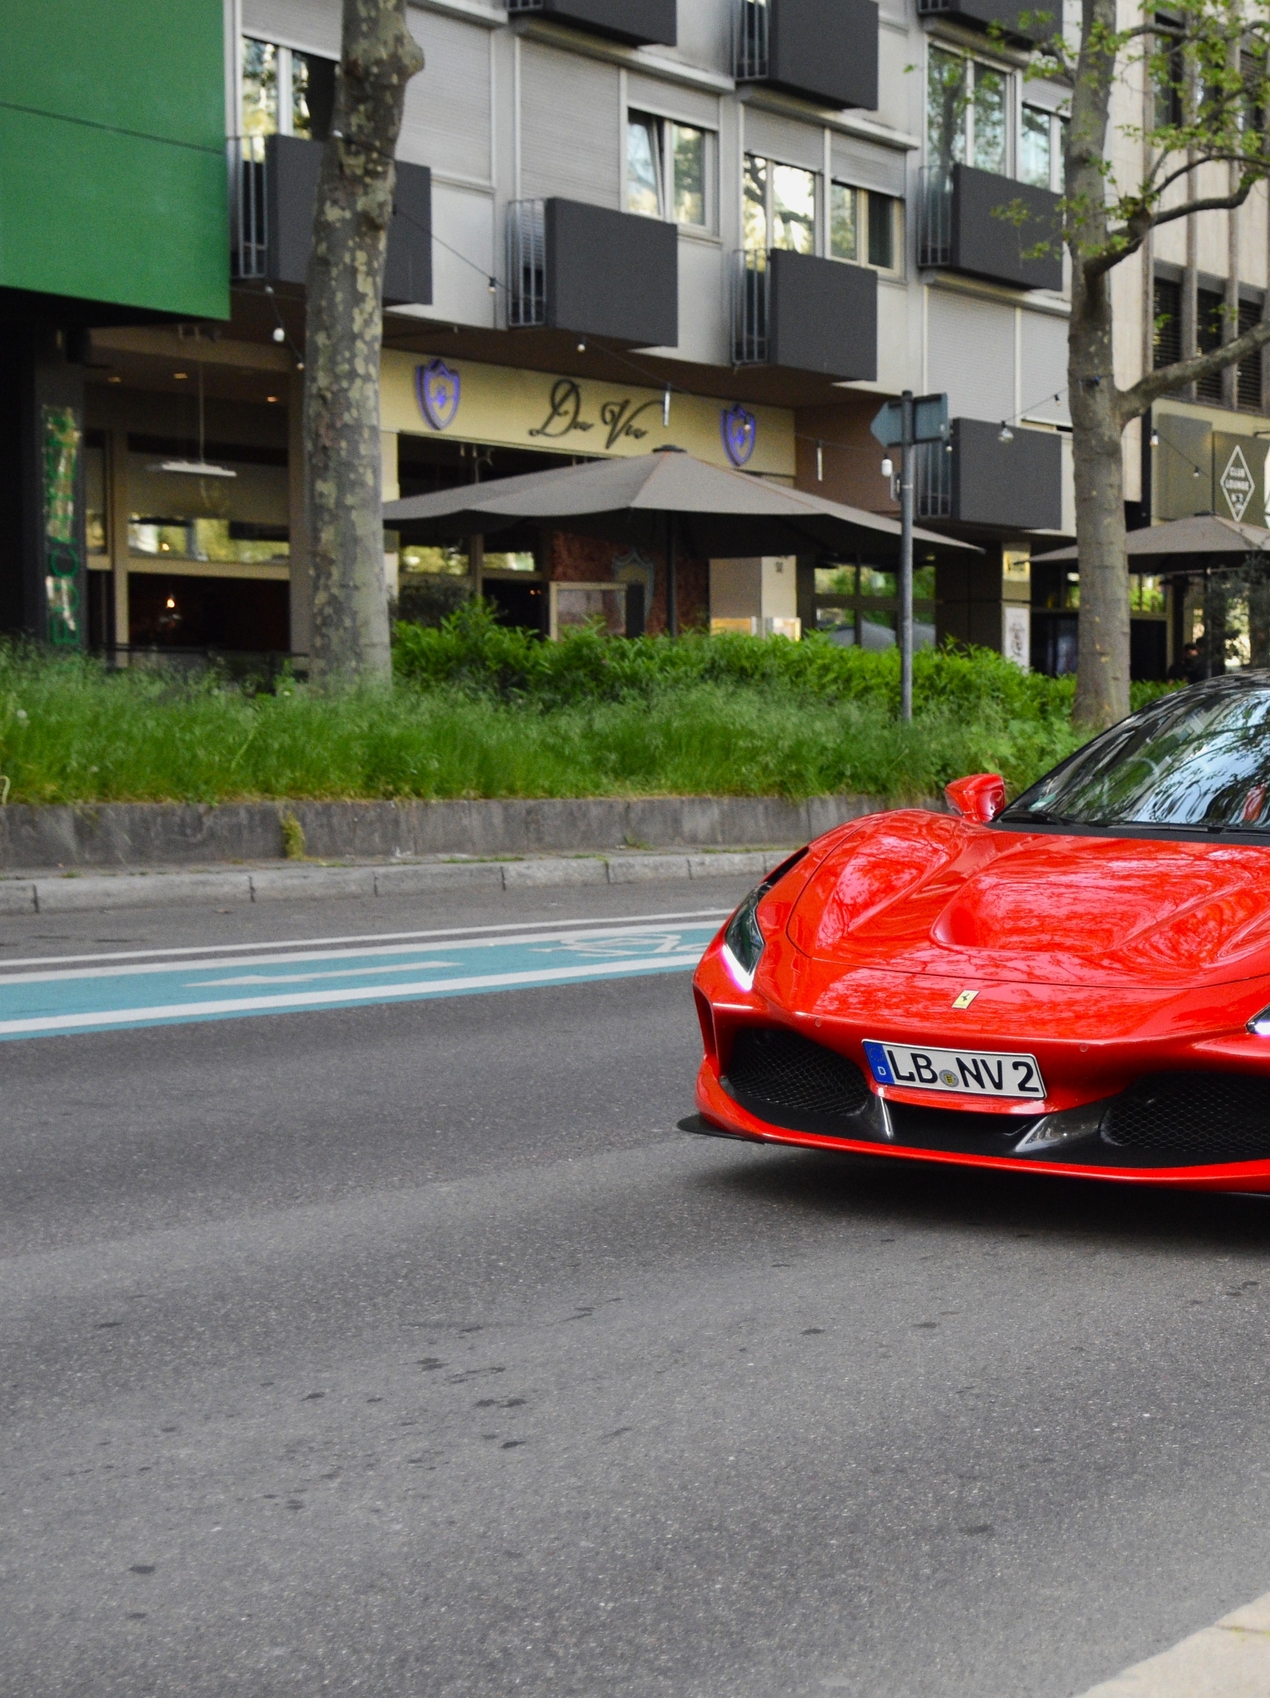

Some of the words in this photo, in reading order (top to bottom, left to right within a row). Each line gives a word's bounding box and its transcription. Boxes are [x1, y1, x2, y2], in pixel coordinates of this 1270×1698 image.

[877, 1066, 887, 1076] D
[887, 1050, 939, 1084] LB
[955, 1057, 1003, 1090] NV
[1012, 1061, 1040, 1092] 2
